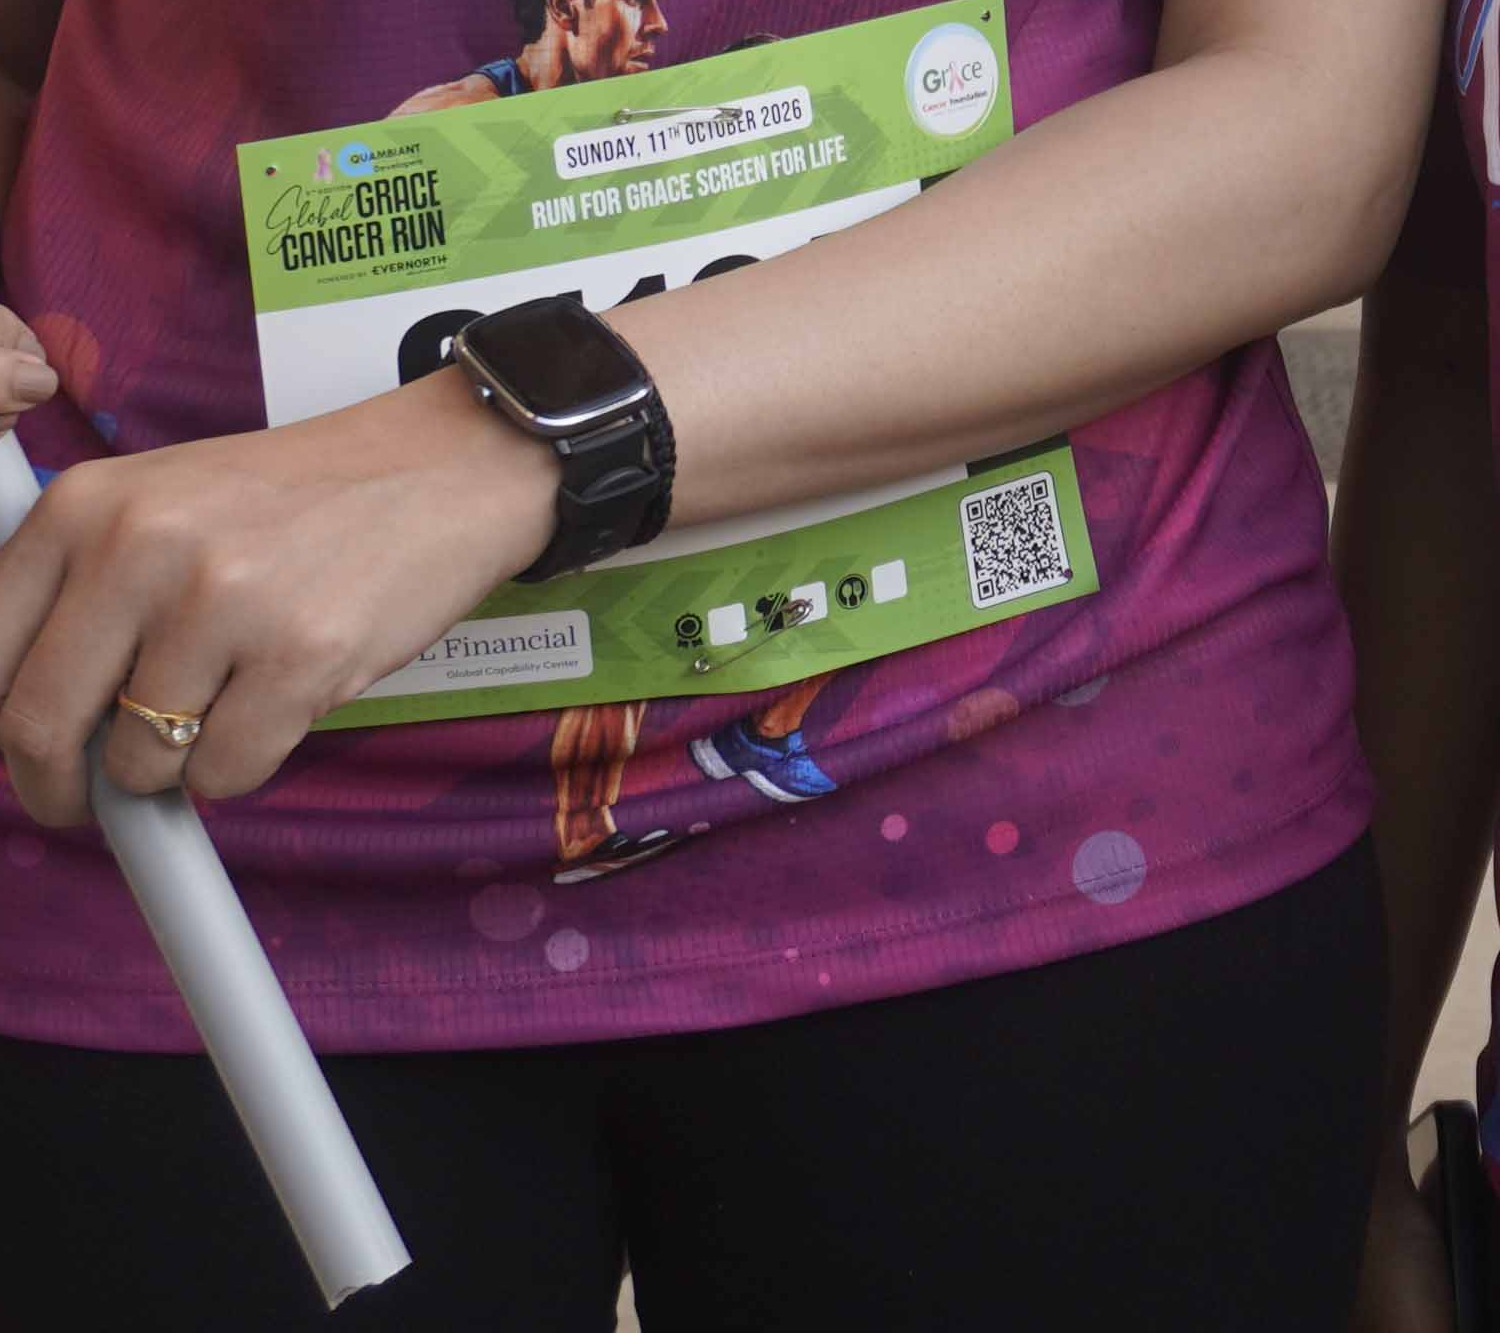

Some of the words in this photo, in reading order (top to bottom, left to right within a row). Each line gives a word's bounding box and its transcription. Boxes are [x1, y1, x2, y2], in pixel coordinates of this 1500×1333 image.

[350, 144, 421, 165] QUAMBIANT
[566, 134, 641, 169] SUNDAY,
[761, 98, 802, 127] 2026
[356, 170, 441, 218] GRACE
[531, 195, 577, 230] RUN
[580, 189, 622, 220] FOR
[625, 172, 693, 211] GRACE
[696, 156, 768, 197] SCREEN
[771, 146, 808, 179] FOR
[809, 134, 847, 169] LIFE
[281, 220, 385, 272] CANCER
[391, 209, 446, 253] RUN
[371, 254, 448, 276] EVERNORTH
[443, 625, 578, 661] Financial
